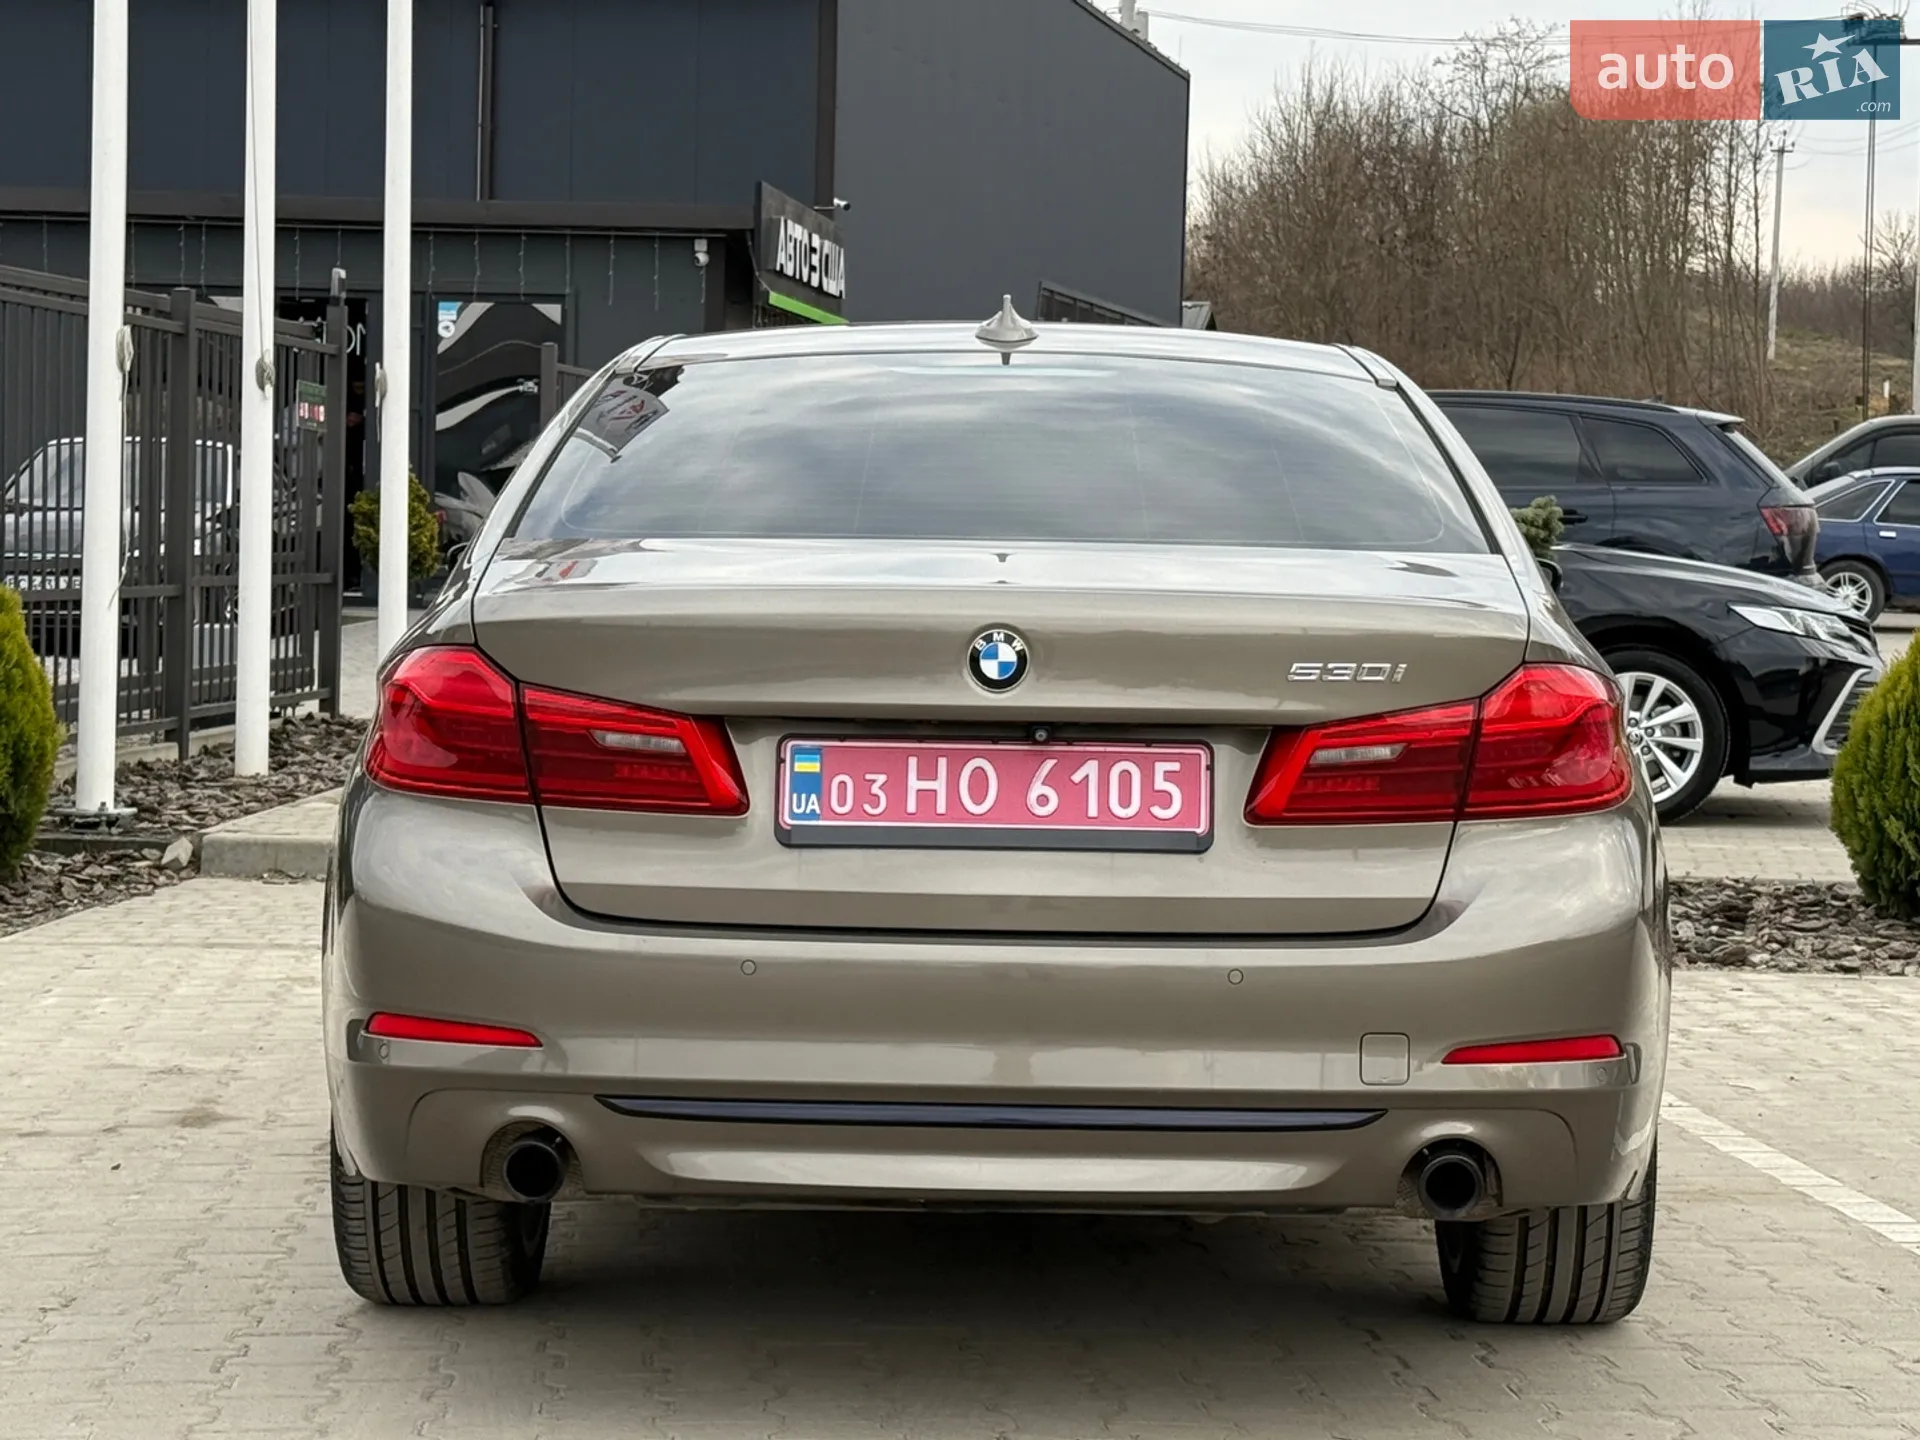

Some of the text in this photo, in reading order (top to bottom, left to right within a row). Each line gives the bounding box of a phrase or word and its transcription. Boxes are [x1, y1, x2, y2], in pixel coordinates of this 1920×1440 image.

[775, 216, 810, 283] АВТО
[821, 238, 846, 300] США
[974, 631, 1024, 652] BMW
[1286, 662, 1408, 683] 530i
[829, 755, 1183, 820] 03 HO 6105
[792, 792, 821, 815] UA
